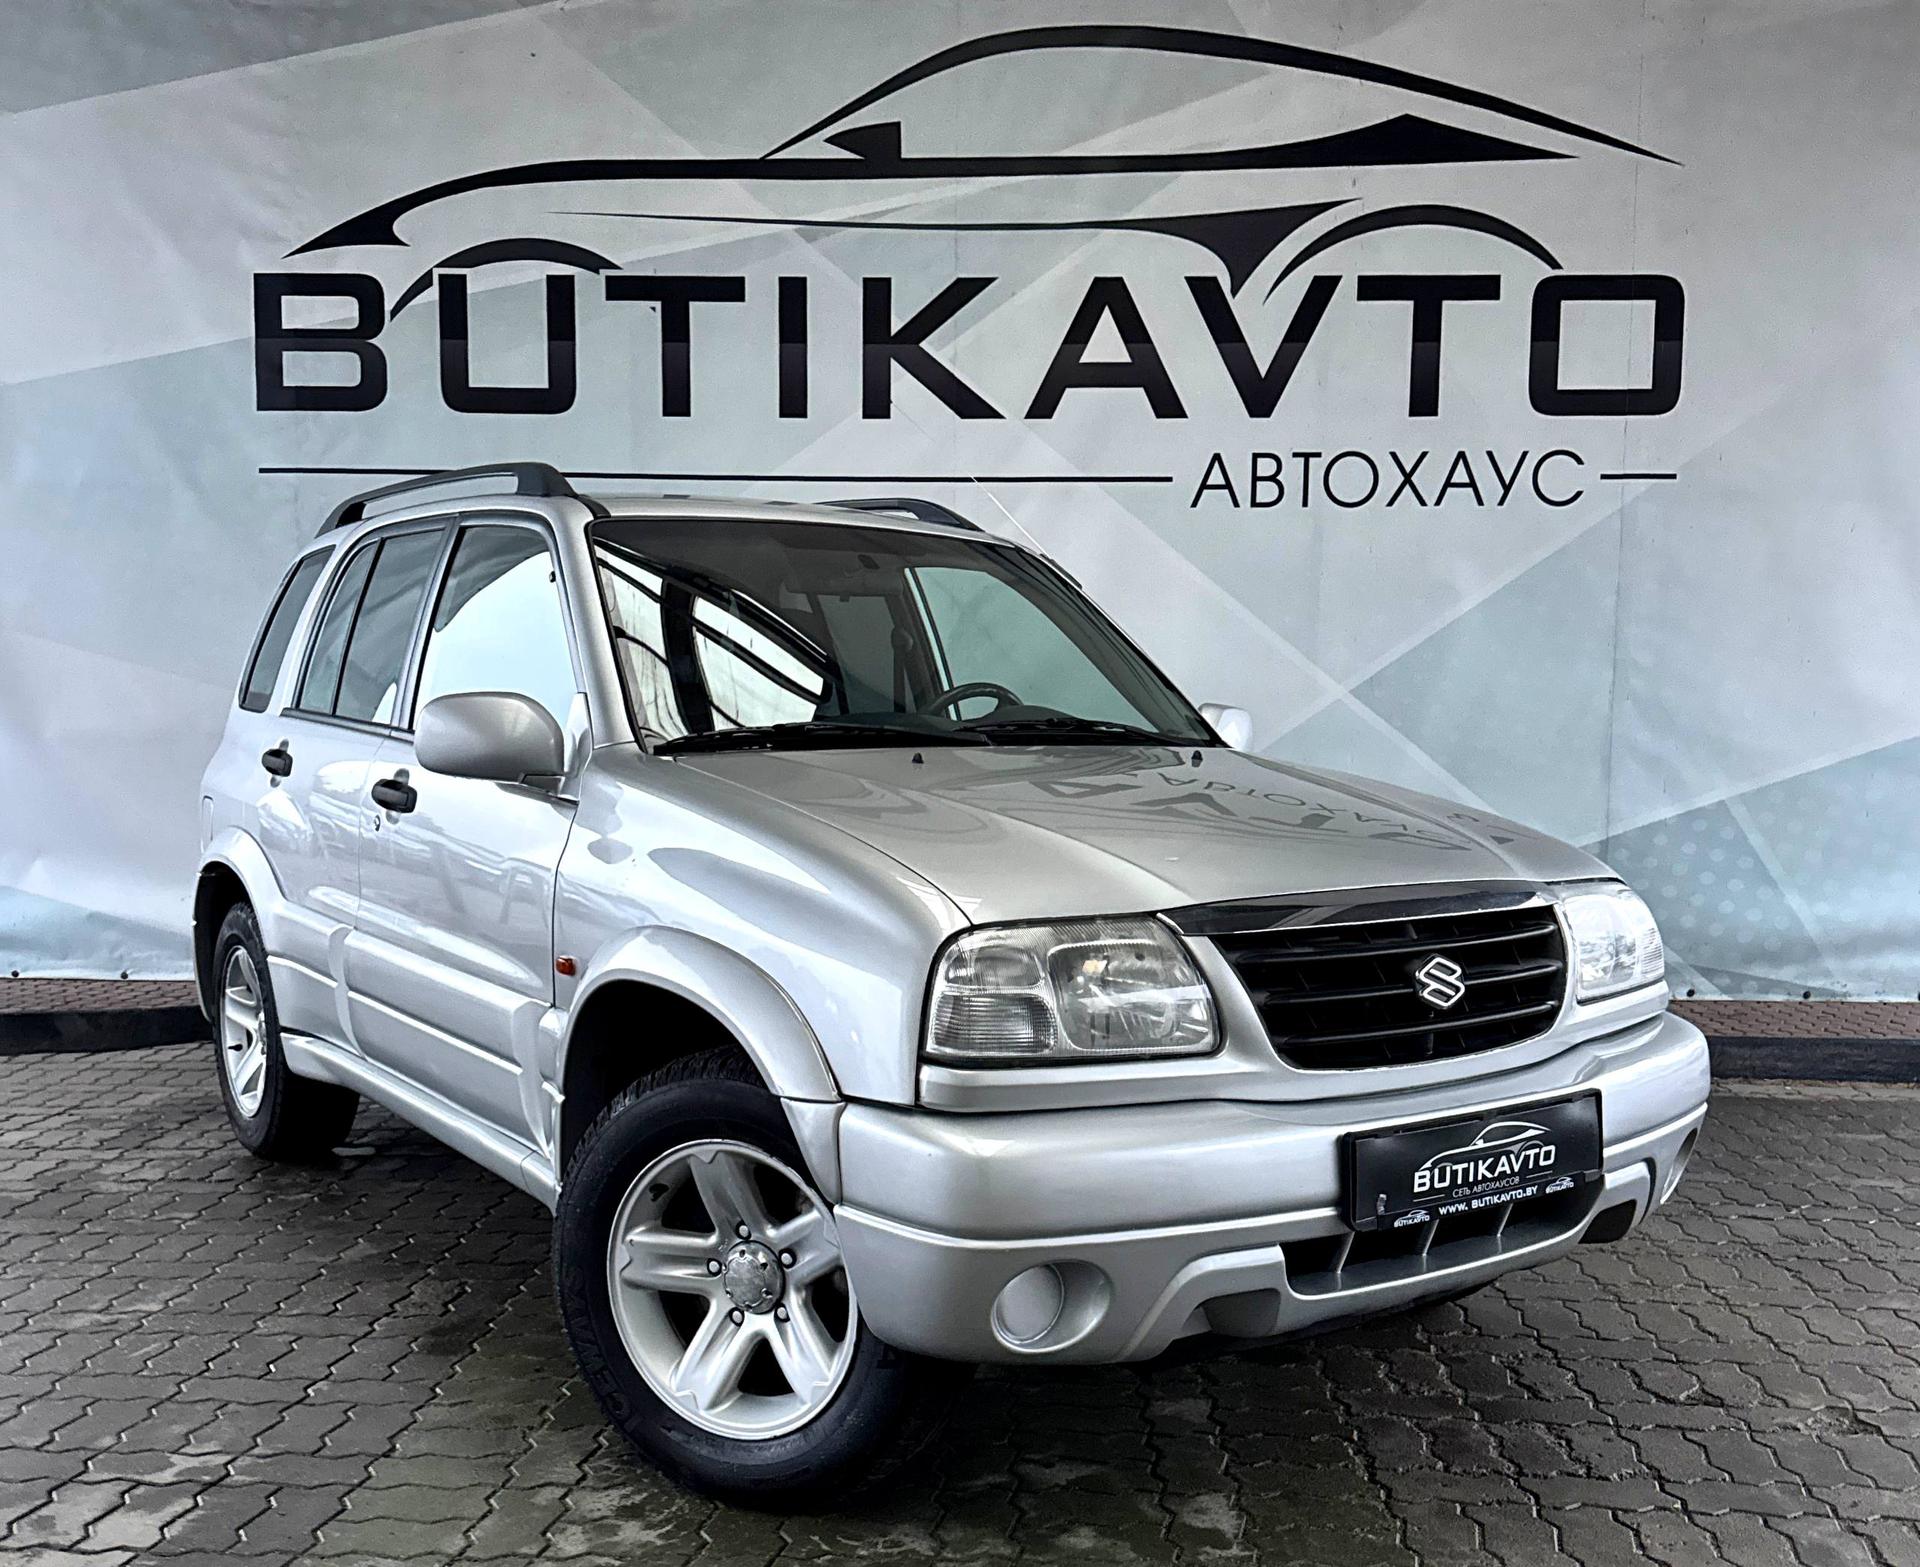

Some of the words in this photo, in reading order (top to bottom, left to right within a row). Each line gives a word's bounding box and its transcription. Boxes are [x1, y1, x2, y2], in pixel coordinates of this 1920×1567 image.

[253, 272, 1684, 419] BUTIKAVTO
[1190, 449, 1585, 508] АВТОХАУС
[1413, 1144, 1556, 1193] BUTIKAVTO
[1452, 1186, 1471, 1198] СЕТЬ
[1472, 1175, 1520, 1194] АВТОХАУСОВ
[1394, 1214, 1430, 1228] BUTIKAVTO
